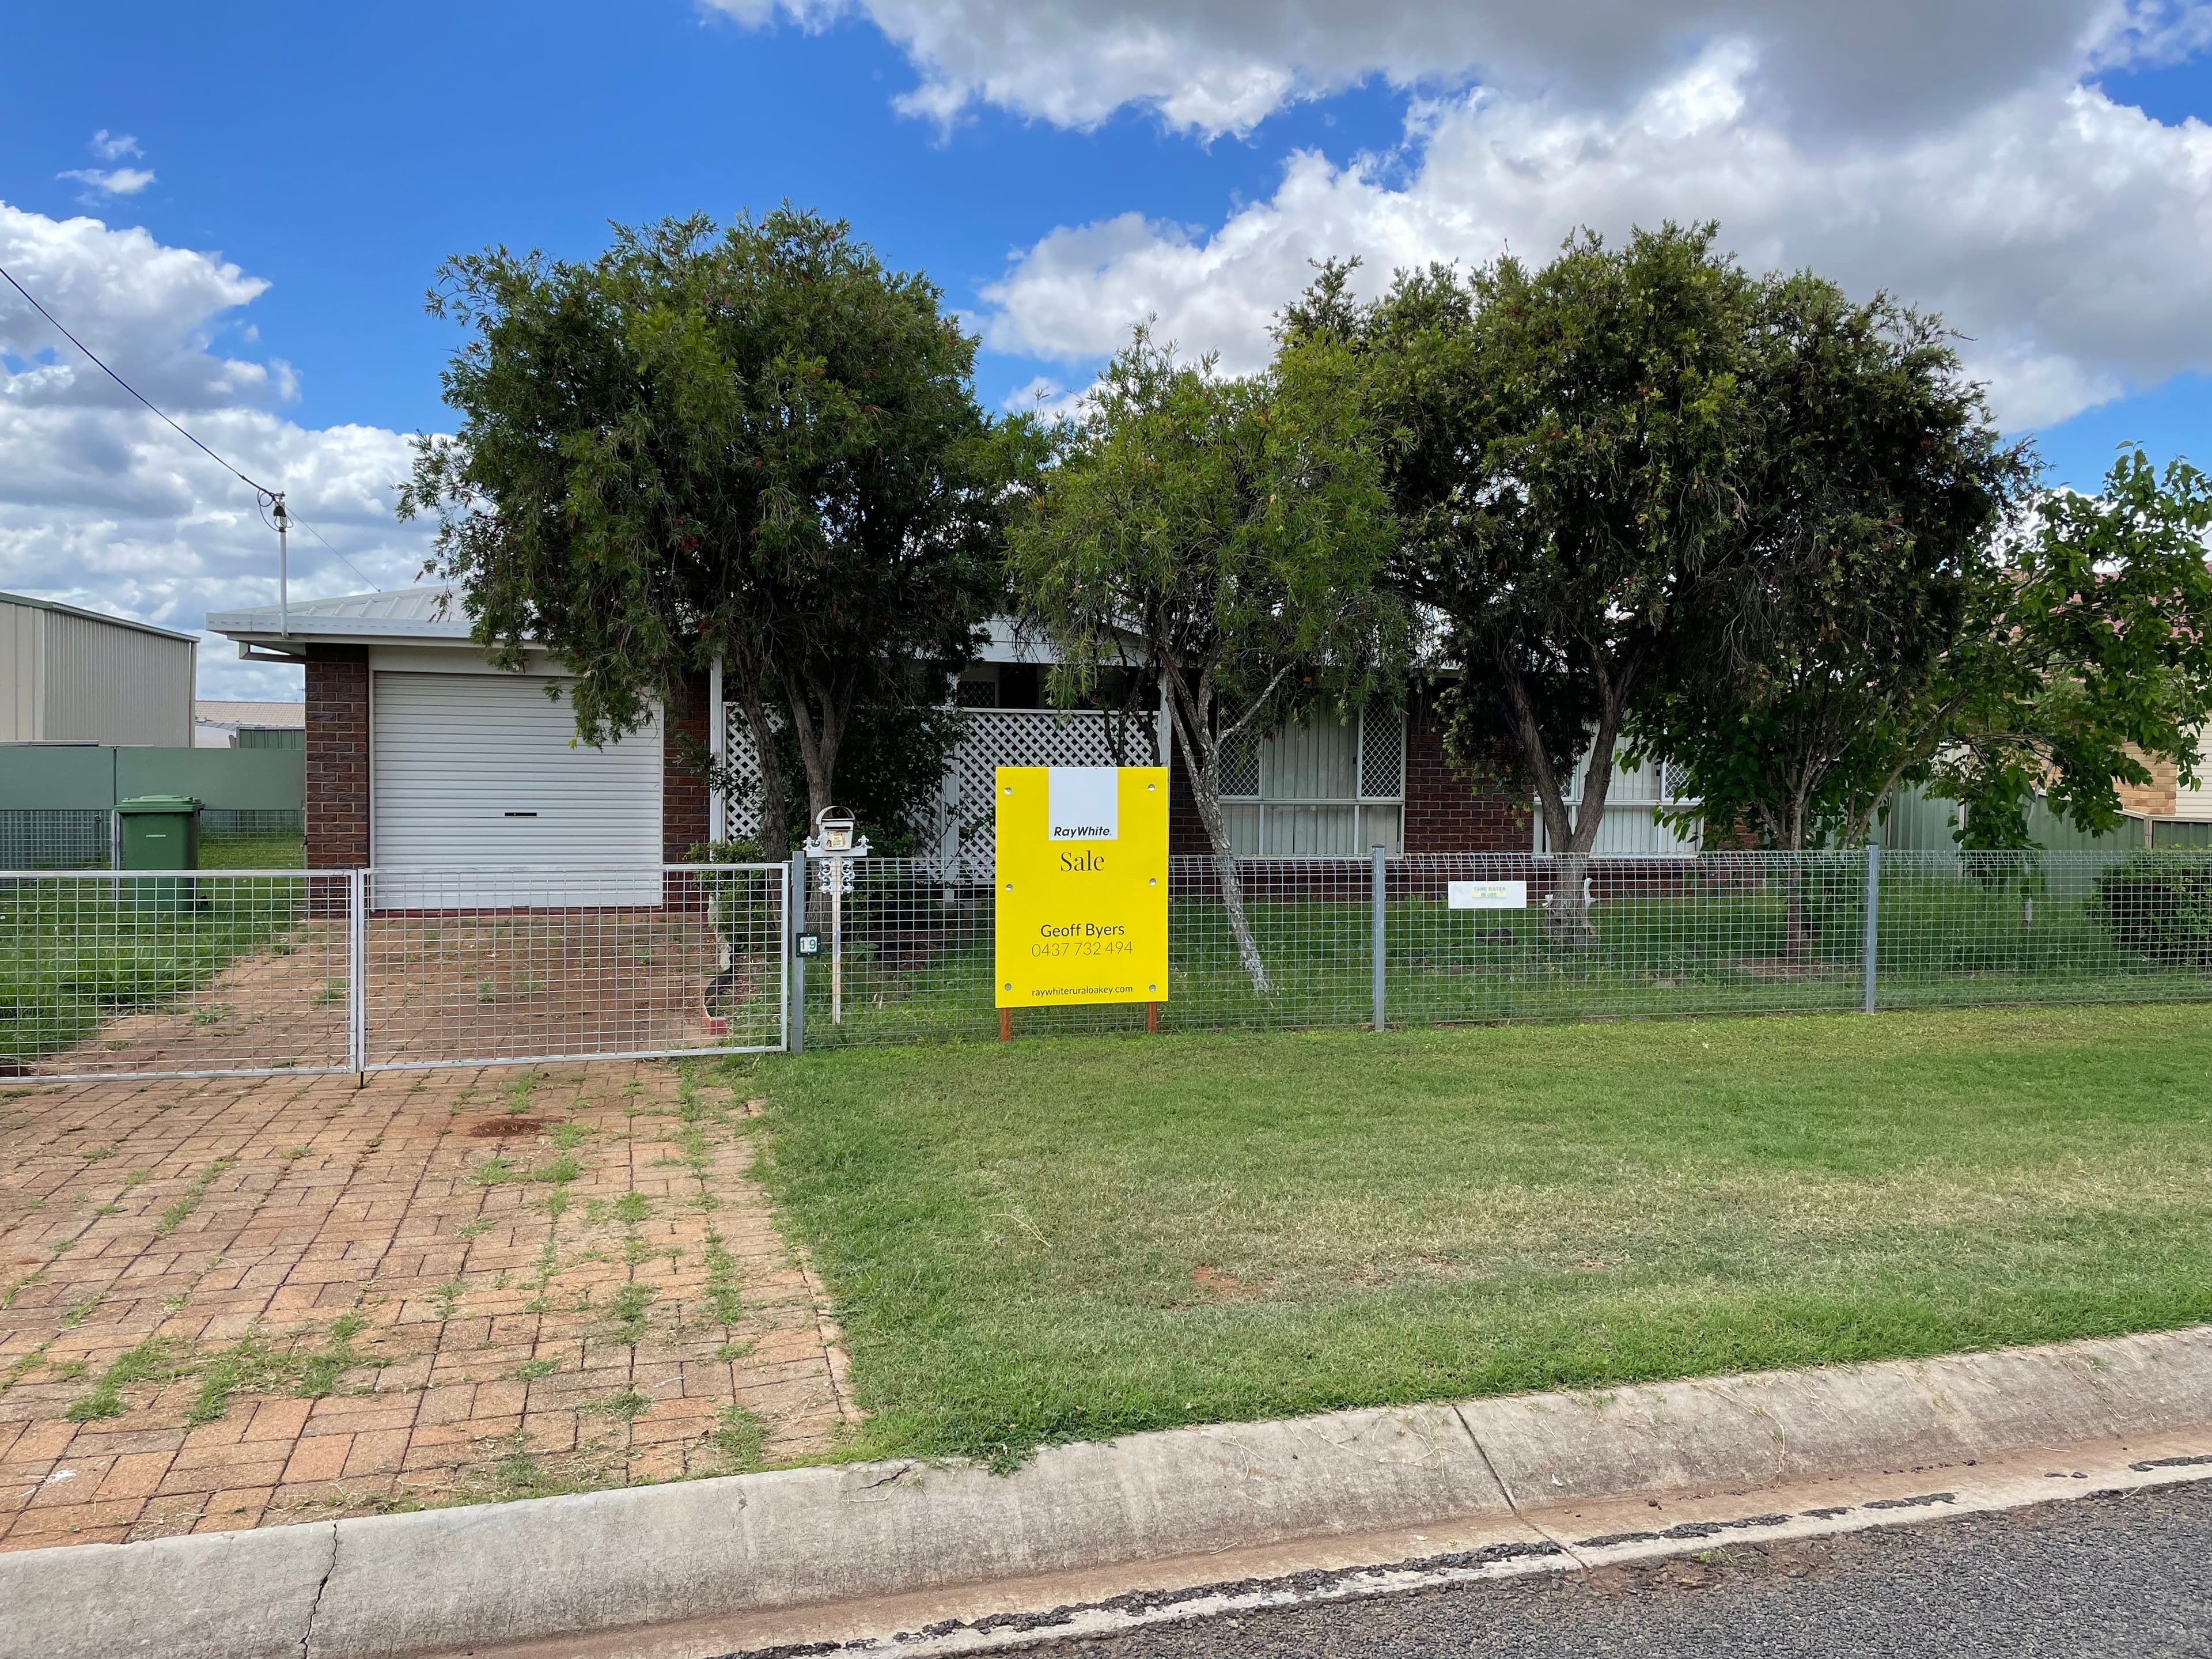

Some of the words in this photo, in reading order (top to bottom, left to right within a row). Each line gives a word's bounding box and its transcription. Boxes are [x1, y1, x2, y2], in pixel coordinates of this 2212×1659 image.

[1060, 850, 1105, 872] Sale
[1040, 924, 1081, 938] Geoff
[1085, 923, 1124, 938] Byers
[801, 939, 816, 949] 19
[1031, 942, 1070, 957] 0437
[1074, 942, 1101, 956] 732
[1105, 941, 1132, 955] 494
[1032, 986, 1133, 997] raywhiteruraloakey.com
